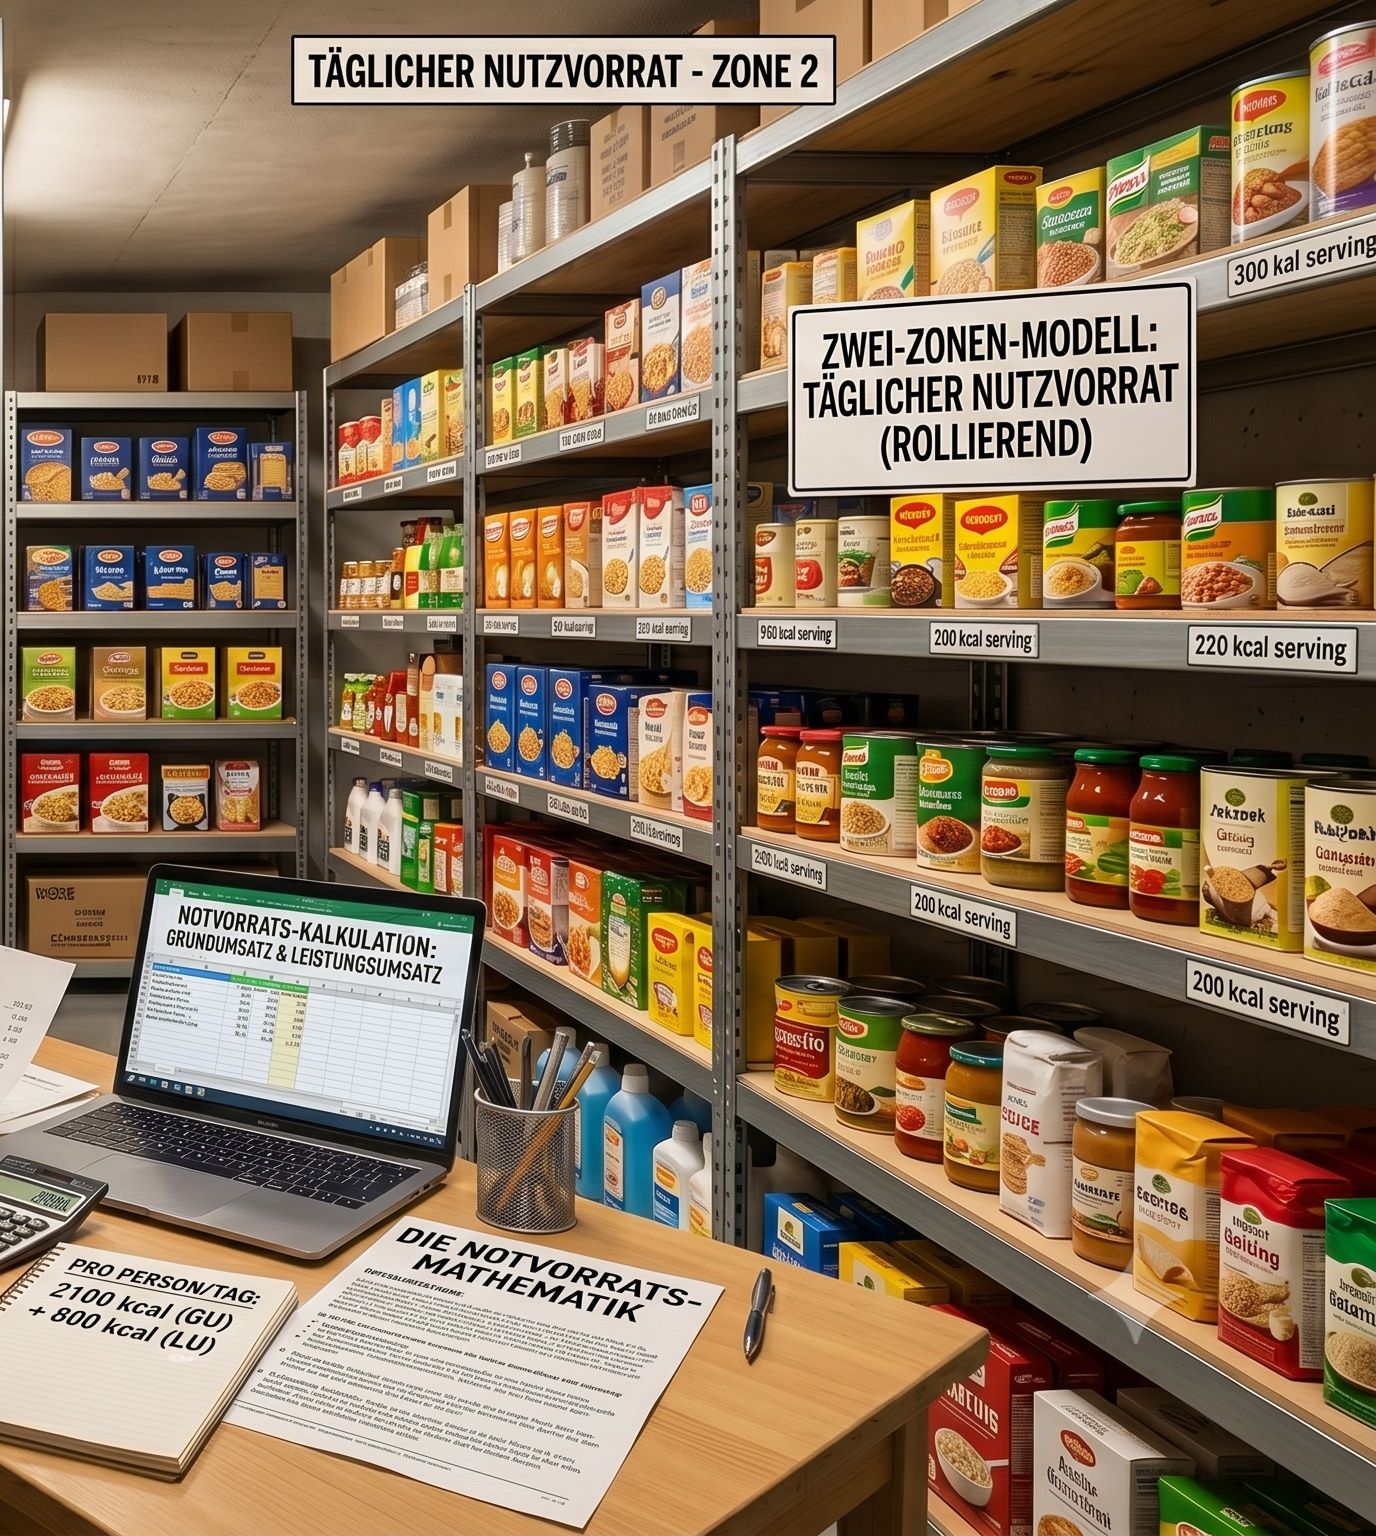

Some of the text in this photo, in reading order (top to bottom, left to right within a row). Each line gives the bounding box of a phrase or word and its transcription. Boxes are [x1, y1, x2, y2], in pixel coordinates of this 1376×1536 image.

[309, 46, 474, 88] TÄGLICHER
[484, 53, 683, 88] NUTZVORRAT
[711, 53, 791, 88] ZONE
[800, 53, 819, 88] 2
[1234, 234, 1376, 286] 300 kal serving
[822, 315, 1158, 370] ZWEI-ZONEN-MODELL:
[803, 363, 1179, 419] TÄGLICHER NUTZVORRAT
[880, 417, 1093, 471] (ROLLIEREND)
[761, 625, 777, 640] 960
[798, 626, 832, 644] serving
[934, 629, 1032, 655] 200 kcal serving
[1195, 634, 1347, 665] 220 kcal serving
[178, 905, 437, 959] NOTVORRATS-KALKULATION:
[914, 891, 1011, 938] 200 kcal serving
[166, 929, 443, 984] GRUNDUMSATZ & LEISTUNGSUMSATZ
[1192, 971, 1340, 1036] 200 kcal serving
[67, 1258, 261, 1305] PRO PERSON/TAG:
[396, 1227, 702, 1307] DIE NOTVORRATS-
[412, 1257, 646, 1324] MATHEMATIK
[28, 1305, 216, 1356] + 800 kcal (LU)
[49, 1282, 234, 1333] 2100 kcal (GU)
